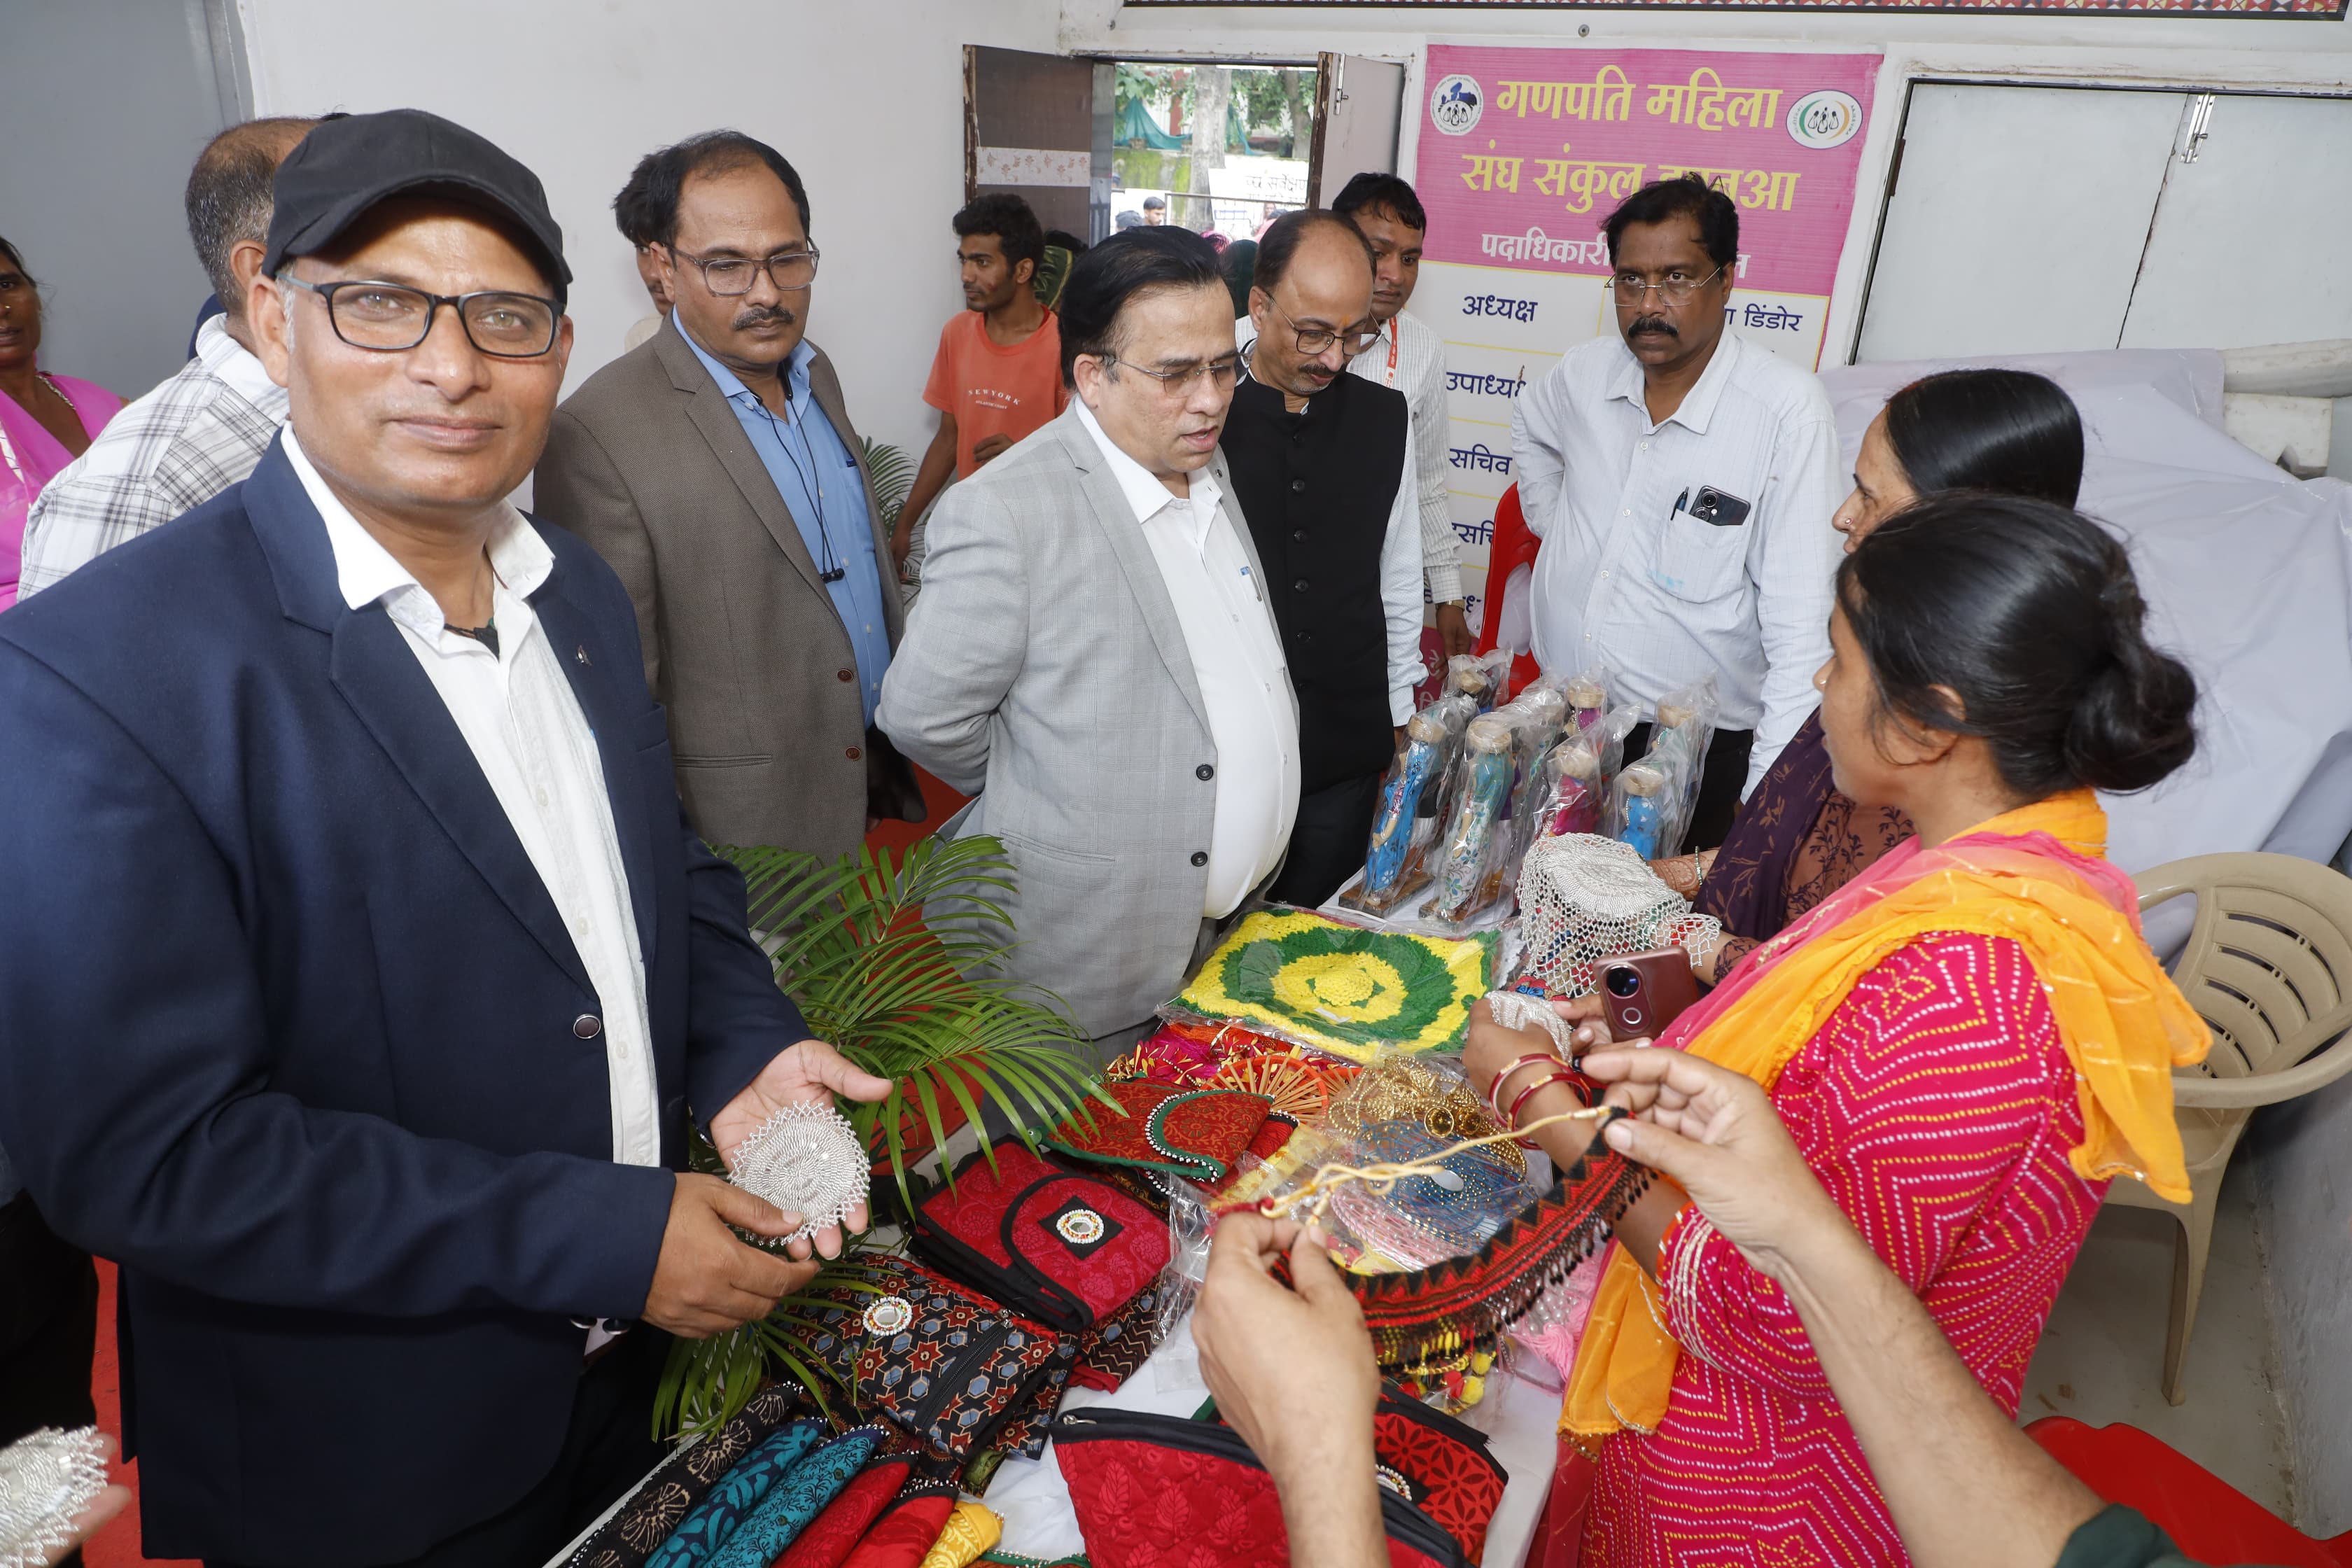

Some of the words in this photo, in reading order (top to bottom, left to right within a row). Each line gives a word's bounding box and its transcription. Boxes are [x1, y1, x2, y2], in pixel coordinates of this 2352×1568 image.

[1497, 64, 1637, 121] गणपति
[1646, 66, 1784, 132] महिला
[1460, 139, 1525, 193] संघ
[1532, 142, 1647, 214] संकुल
[1462, 294, 1539, 323] अध्यक्ष
[1744, 302, 1803, 332] डिंडोर
[1449, 443, 1513, 475] सचिव
